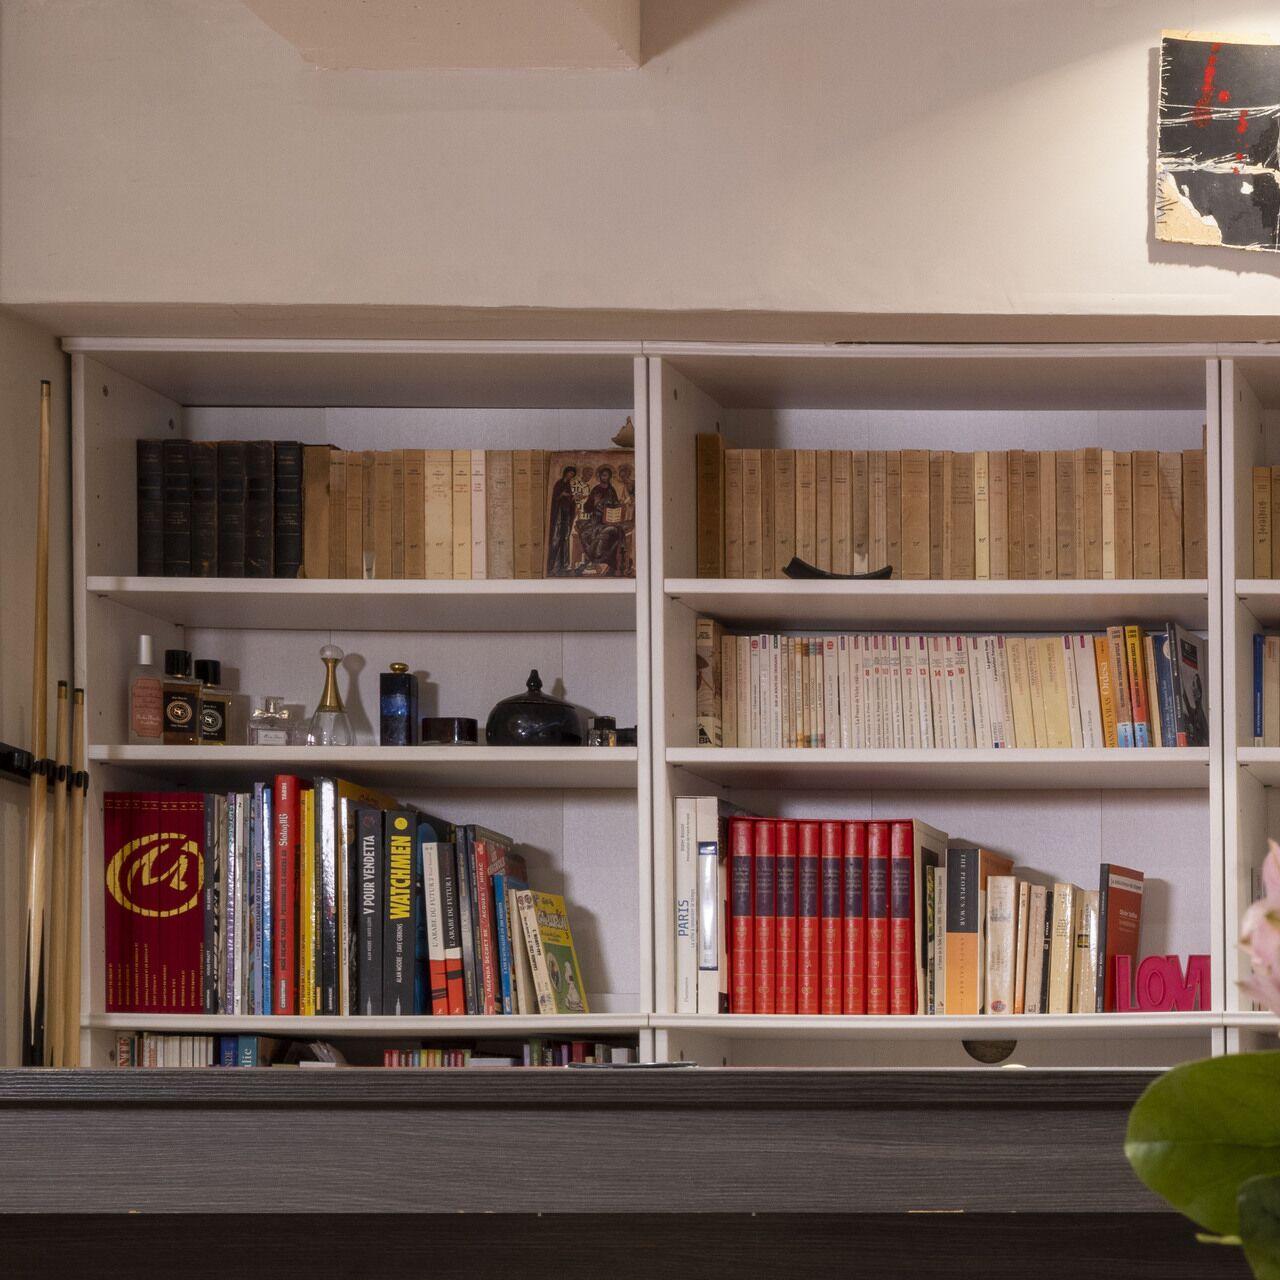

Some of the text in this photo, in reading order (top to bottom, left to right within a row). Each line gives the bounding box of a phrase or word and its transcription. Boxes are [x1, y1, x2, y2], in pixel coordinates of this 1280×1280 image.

[1098, 661, 1110, 695] Ordesa
[362, 835, 376, 914] V POUR VENDETTA
[389, 836, 411, 920] WATCHMEN
[445, 881, 453, 905] FUTUR
[959, 854, 967, 927] THE PEOPLE'S WAR
[677, 900, 689, 937] PARIS
